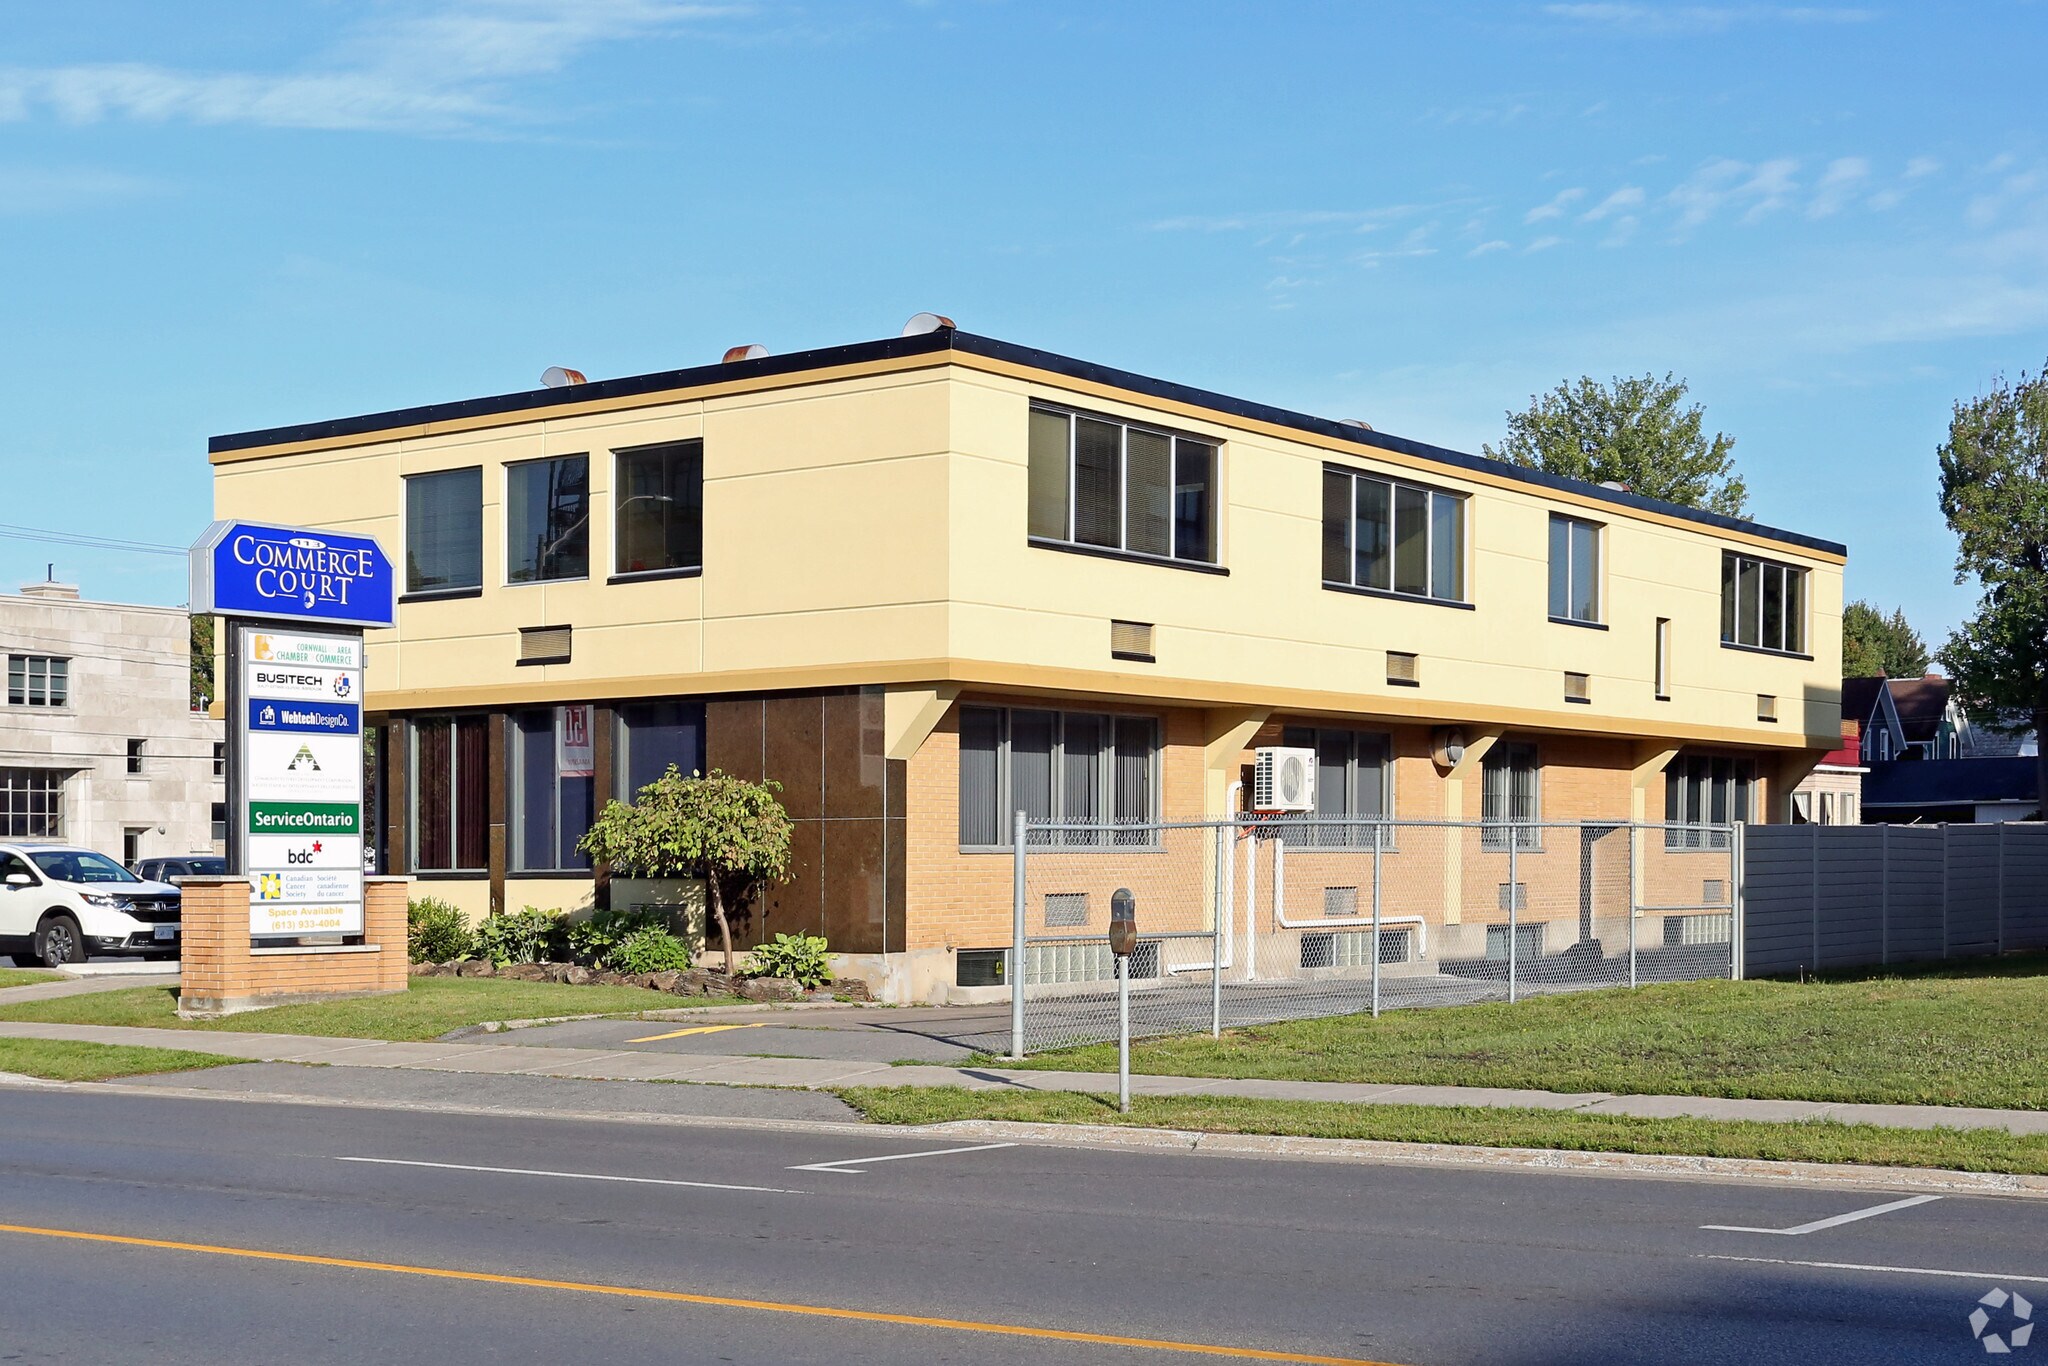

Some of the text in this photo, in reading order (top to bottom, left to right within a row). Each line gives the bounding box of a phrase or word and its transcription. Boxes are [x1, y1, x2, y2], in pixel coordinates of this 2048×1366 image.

[296, 539, 322, 548] 113
[233, 535, 374, 578] COMMERCE
[255, 568, 353, 605] COURT
[296, 643, 327, 653] CORNWALL
[337, 646, 352, 654] AREA
[276, 651, 308, 662] CHAMBER
[315, 653, 352, 665] COMMERCE
[257, 672, 323, 686] BUSITECH
[255, 811, 353, 826] ServiceOntario
[287, 848, 314, 864] bdc
[268, 906, 344, 918] Space Available
[271, 919, 341, 932] (613) 933-4004
